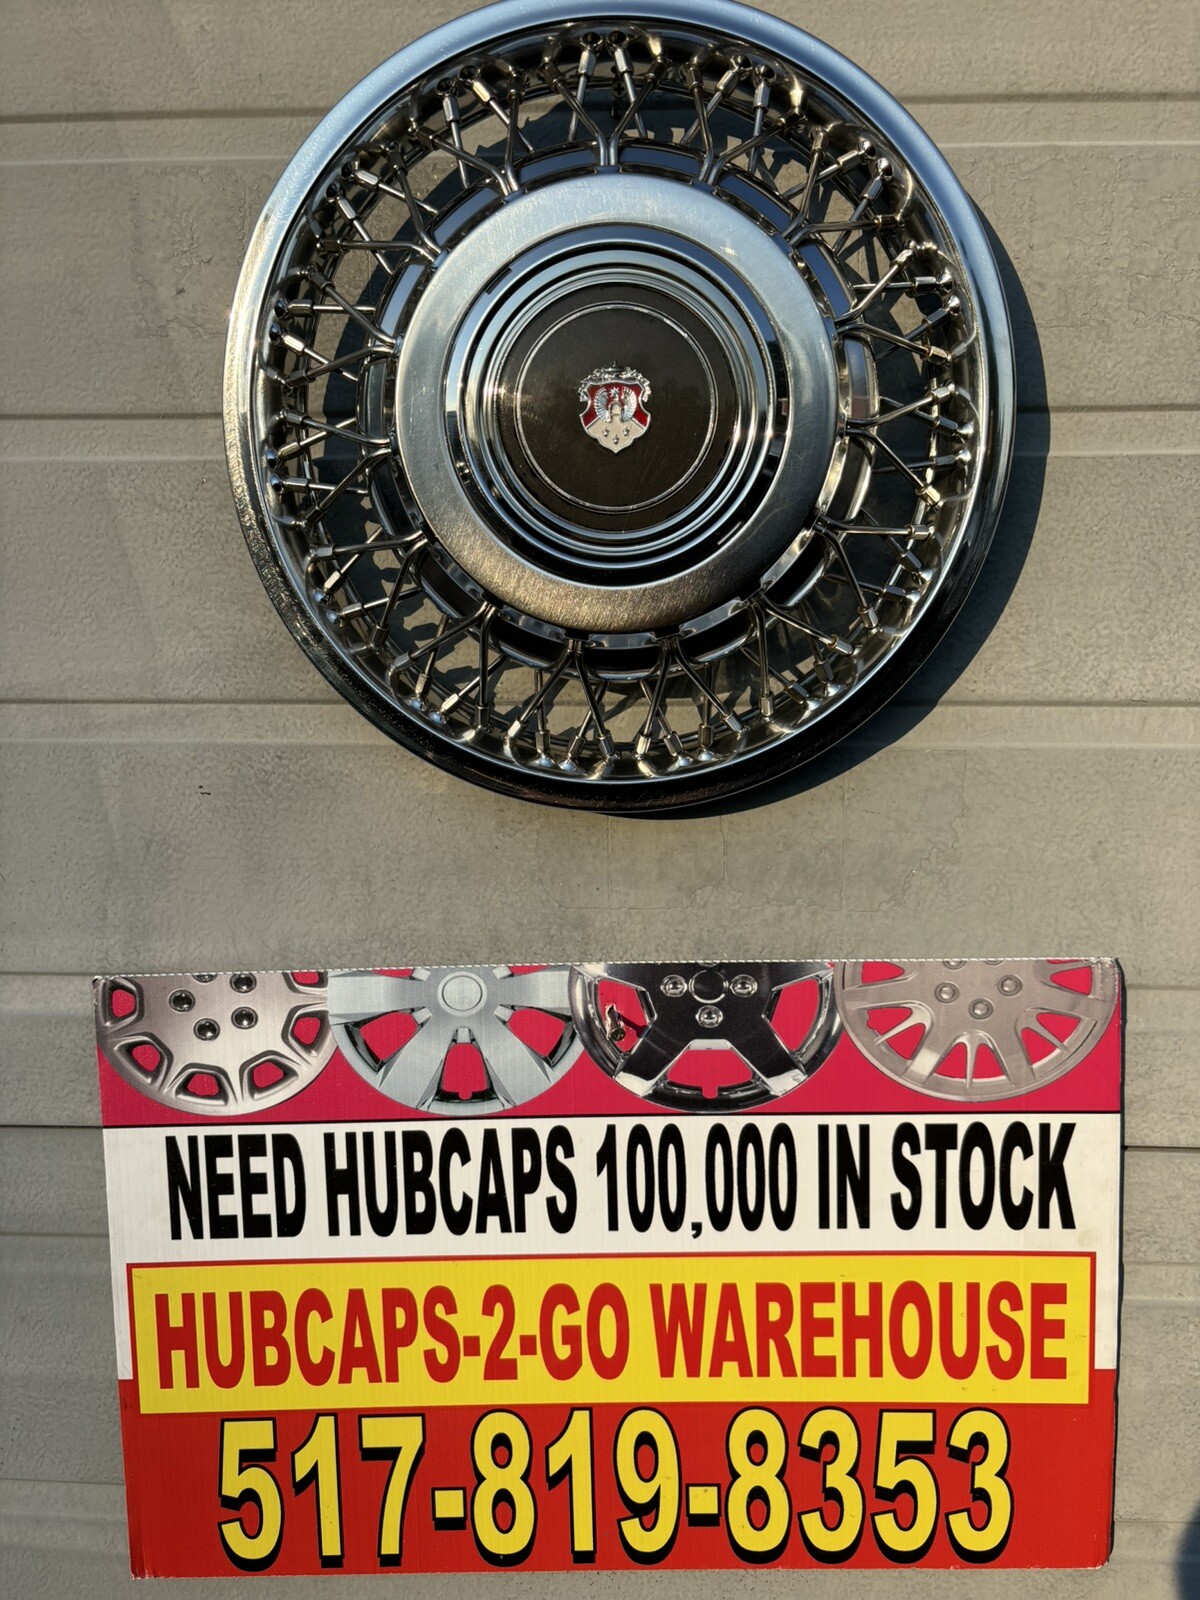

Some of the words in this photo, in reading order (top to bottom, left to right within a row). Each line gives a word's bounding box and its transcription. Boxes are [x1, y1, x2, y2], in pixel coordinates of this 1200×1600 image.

[165, 1132, 306, 1240] NEED
[322, 1124, 578, 1237] HUBCAPS
[596, 1122, 797, 1239] 100,000
[817, 1123, 871, 1230] IN
[890, 1120, 1077, 1231] STOCK
[154, 1282, 630, 1390] HUBCAPS-2-GO
[649, 1279, 1068, 1380] WAREHOUSE
[217, 1406, 1015, 1572] 517-819-8353
